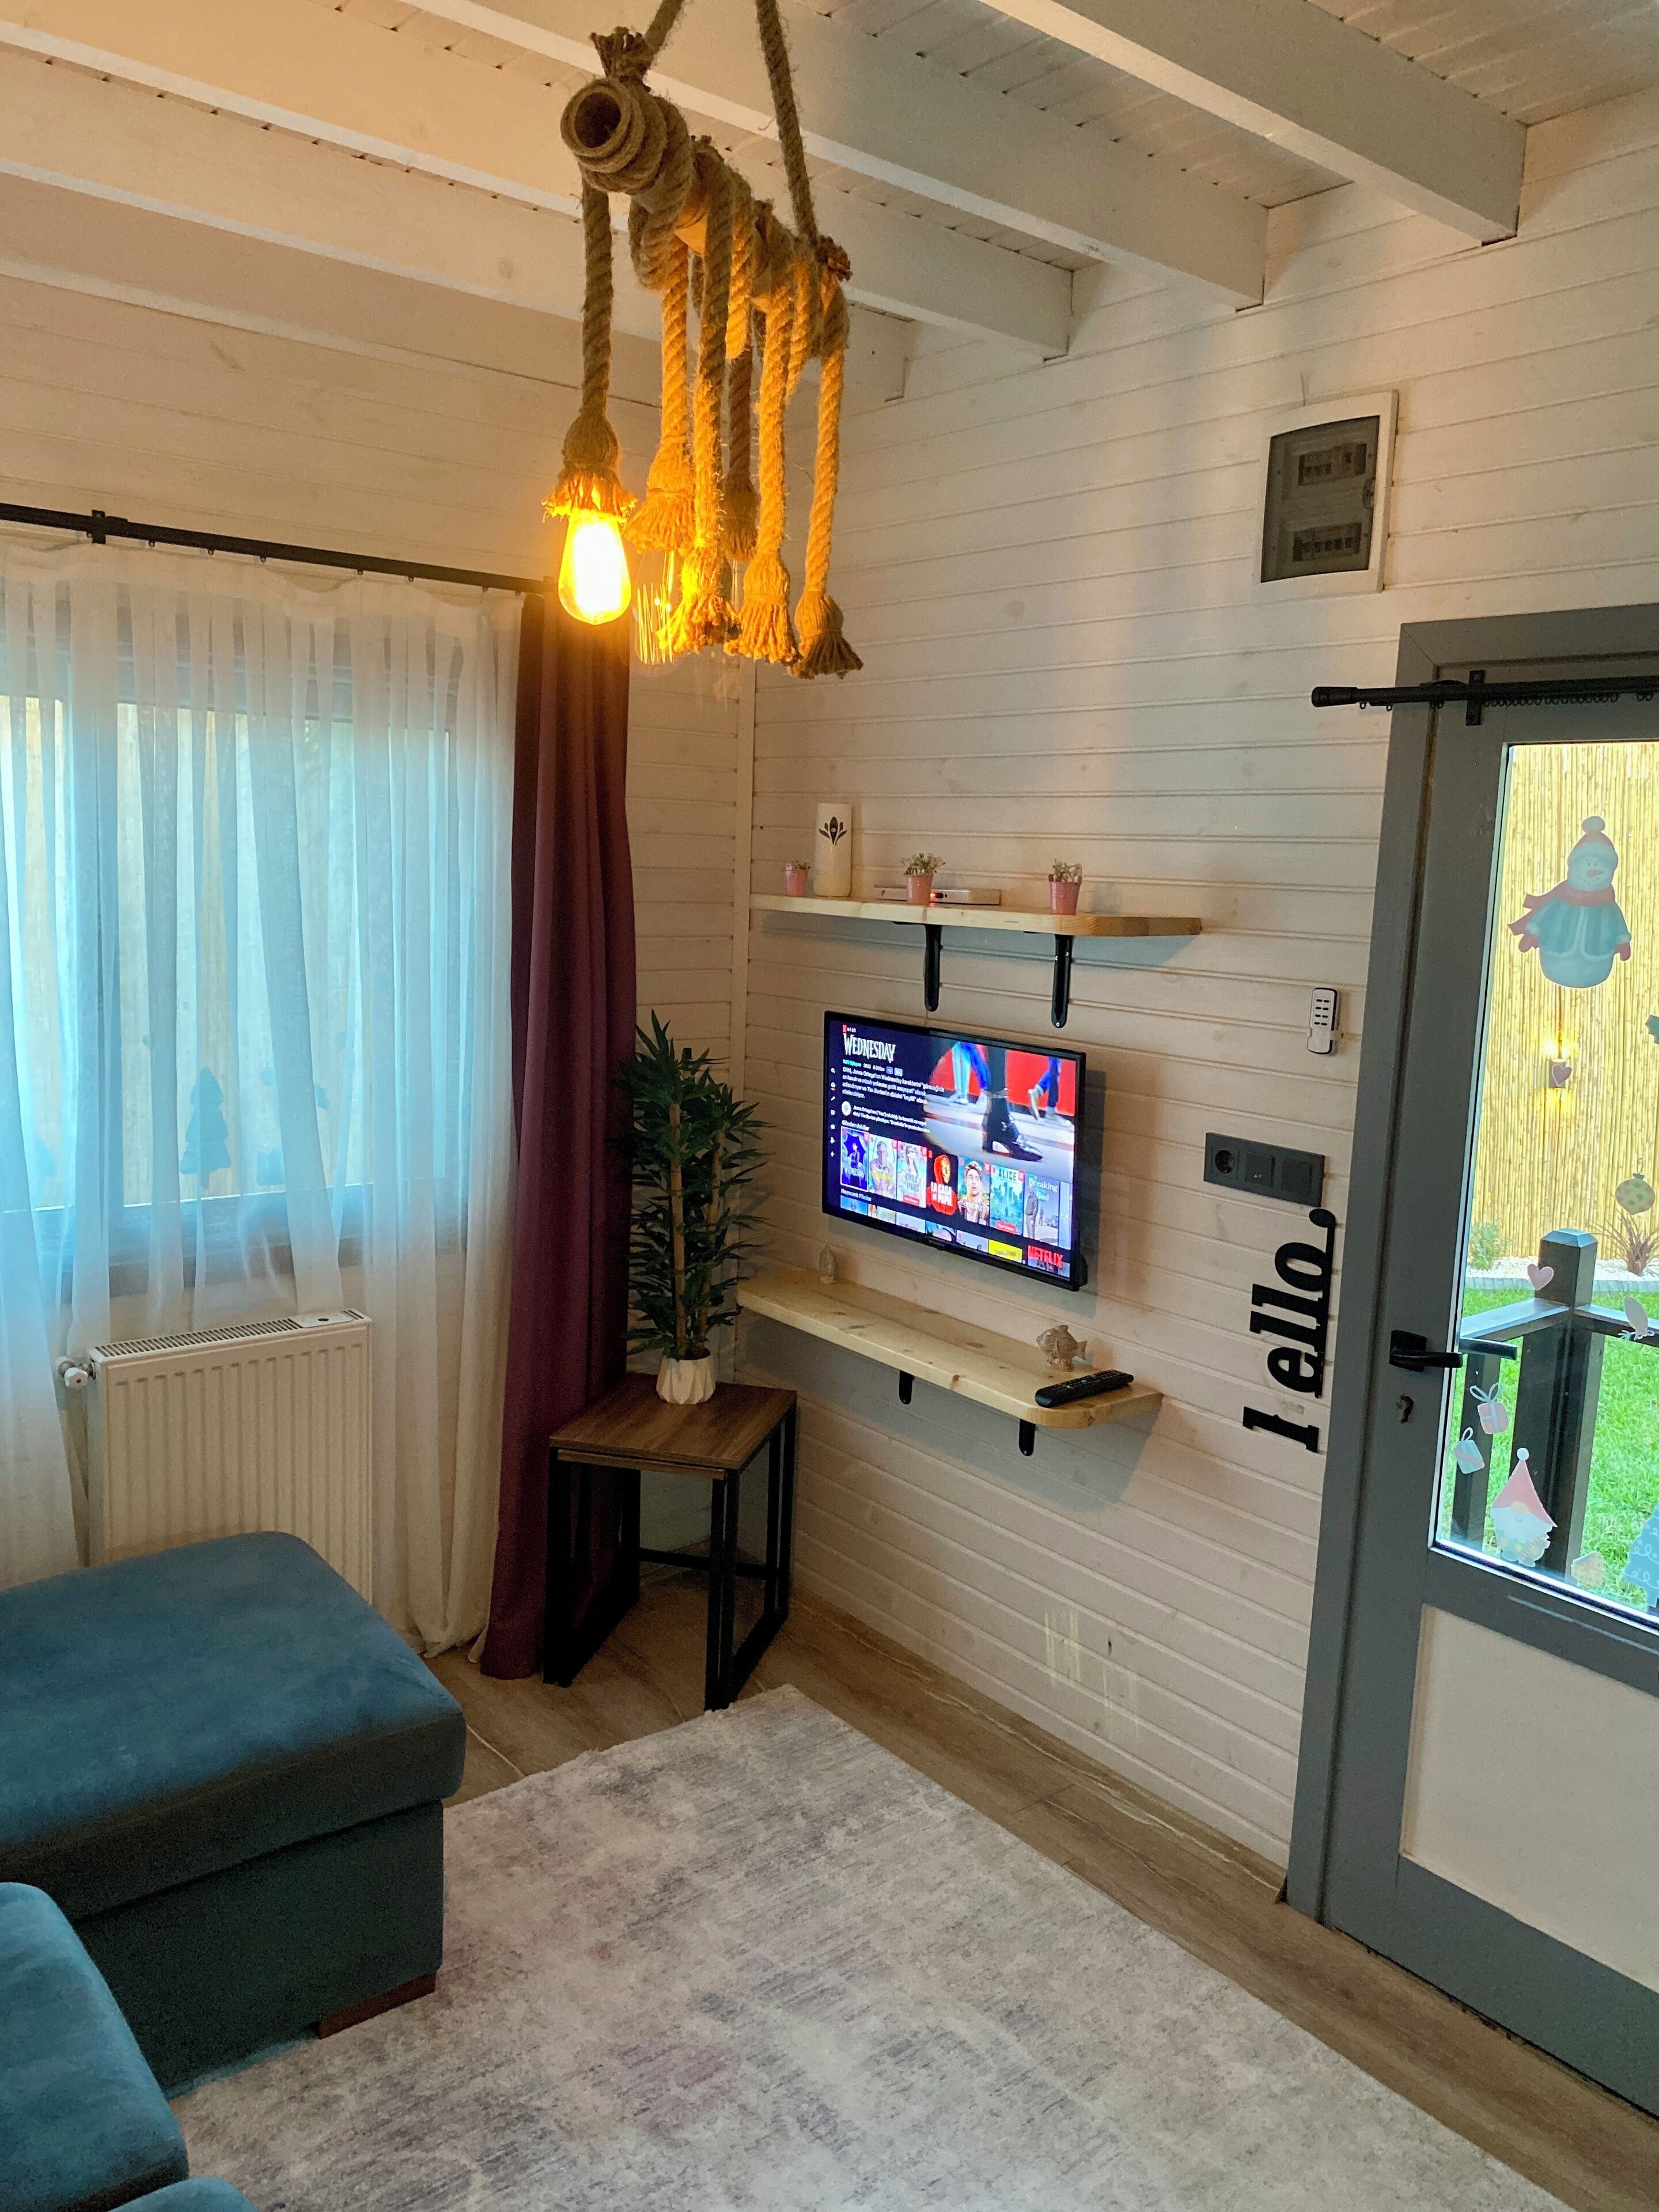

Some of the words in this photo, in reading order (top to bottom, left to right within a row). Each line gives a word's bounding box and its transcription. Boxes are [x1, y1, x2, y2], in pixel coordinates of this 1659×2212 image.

[843, 1033, 896, 1063] WEDNESDAY
[906, 1173, 917, 1183] EMILY
[998, 1168, 1017, 1181] ALICE
[907, 1181, 919, 1192] PARIS
[931, 1181, 937, 1192] LA
[938, 1184, 952, 1194] CASA
[1028, 1177, 1058, 1193] Breaking
[1036, 1191, 1049, 1201] Bad
[1028, 1245, 1063, 1268] NETFLIX
